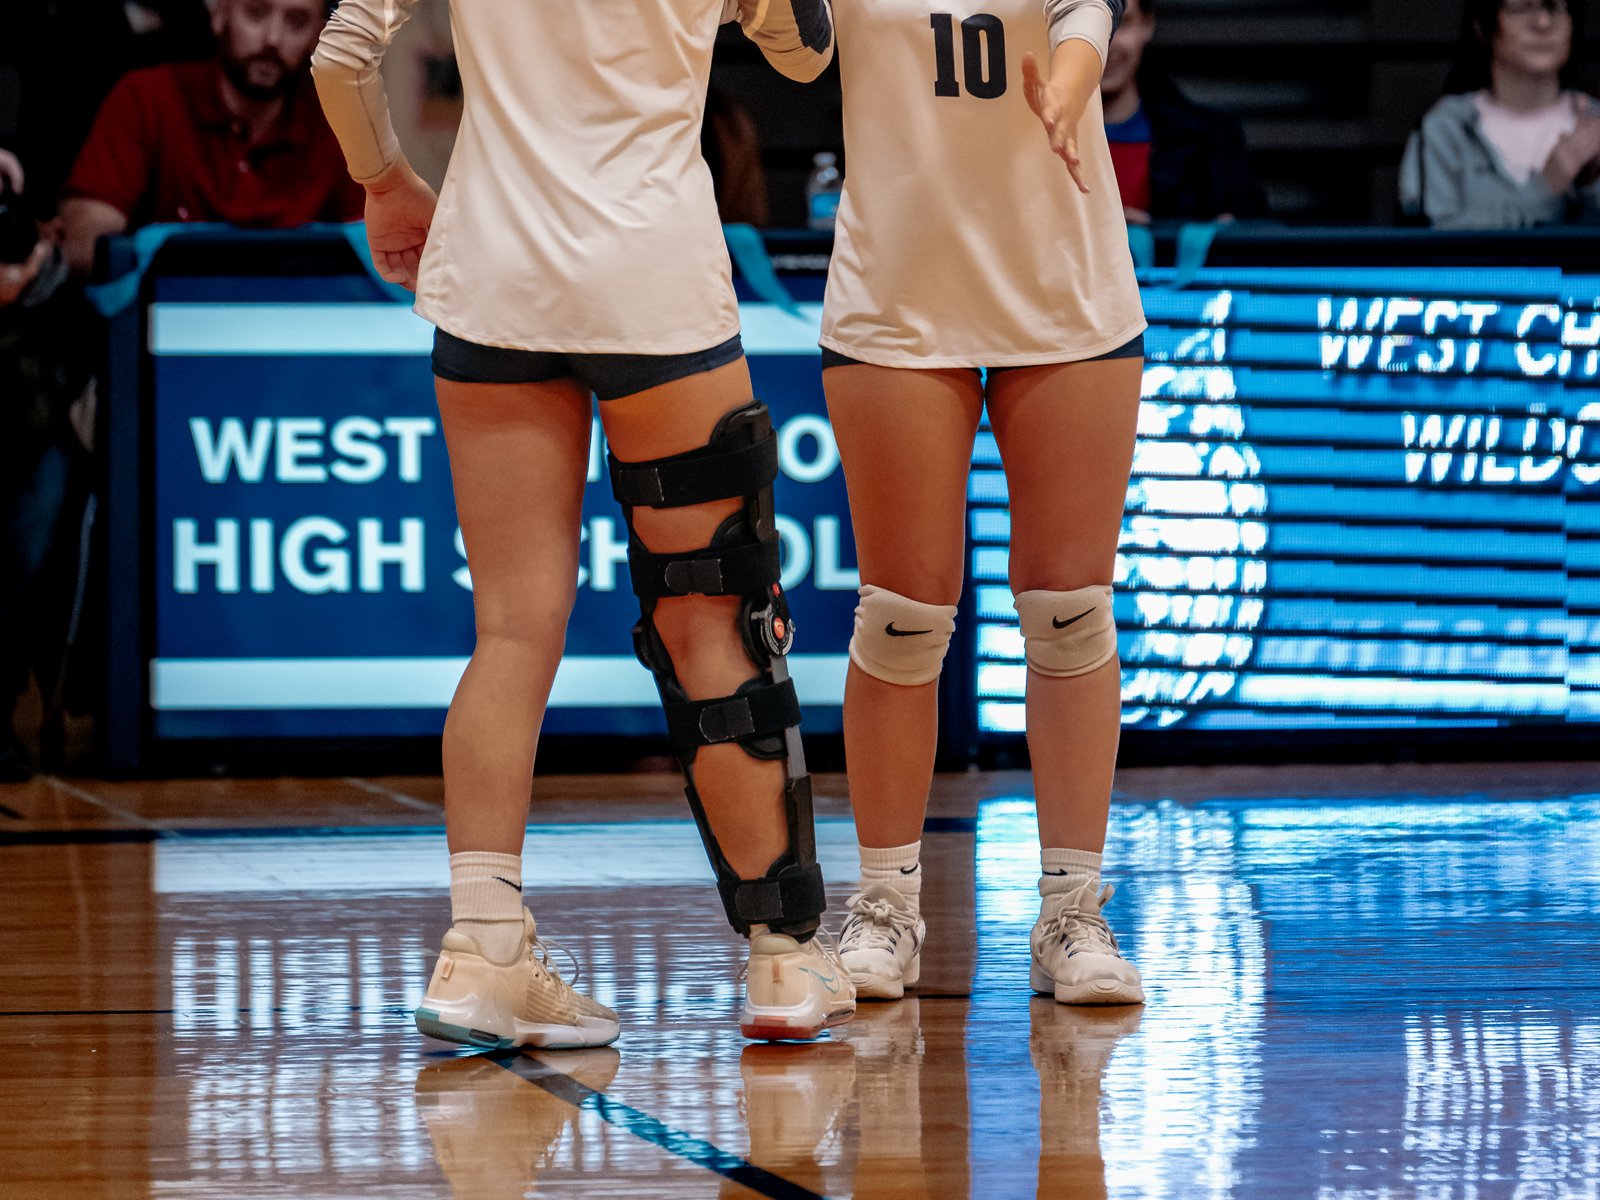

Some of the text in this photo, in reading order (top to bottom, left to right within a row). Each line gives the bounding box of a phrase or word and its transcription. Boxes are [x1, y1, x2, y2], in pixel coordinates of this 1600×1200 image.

[930, 13, 1007, 99] 10
[1317, 297, 1500, 373] WEST
[189, 416, 437, 484] WEST
[173, 515, 426, 595] HIGH
